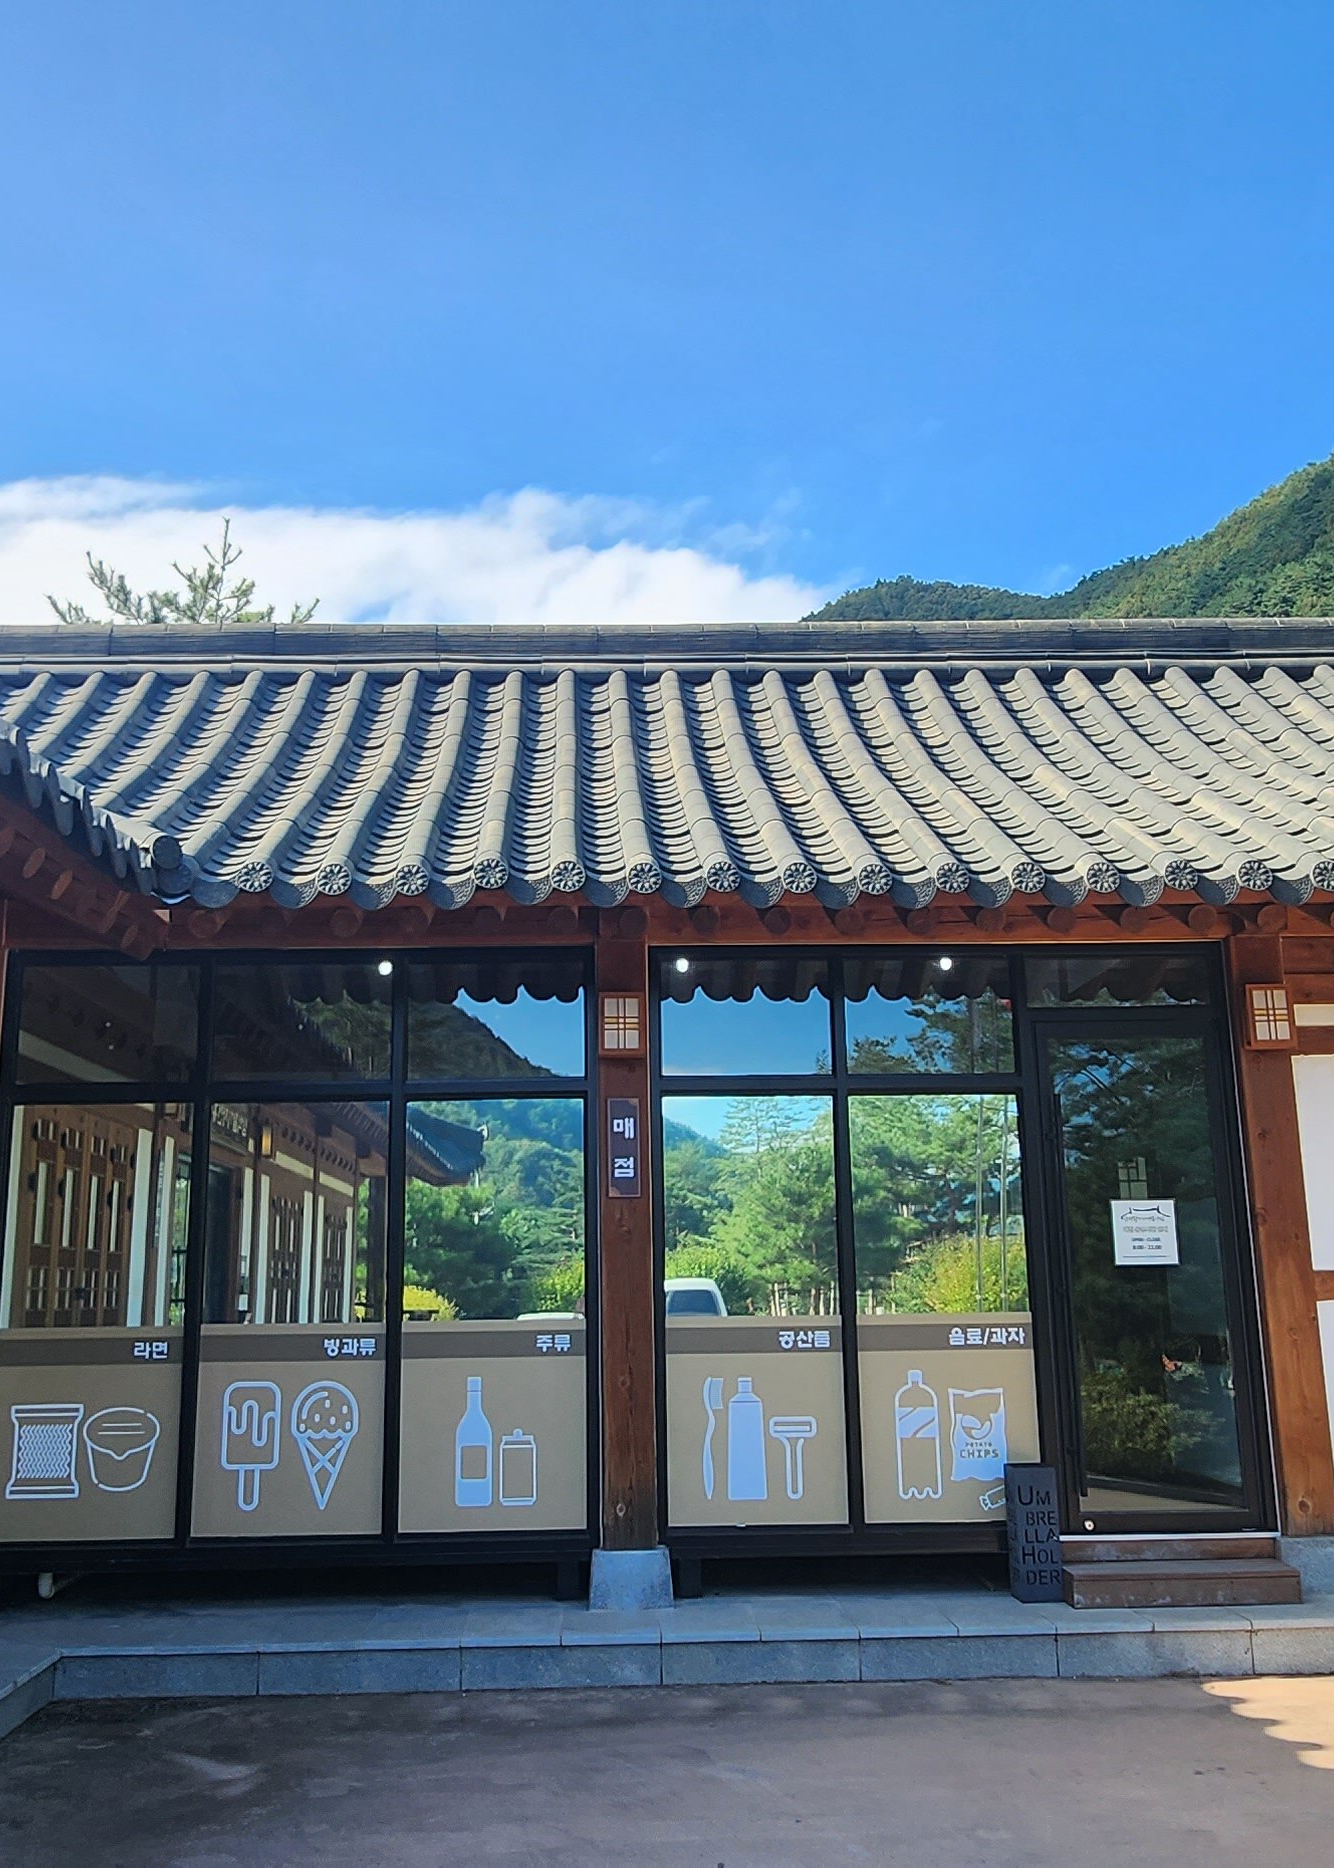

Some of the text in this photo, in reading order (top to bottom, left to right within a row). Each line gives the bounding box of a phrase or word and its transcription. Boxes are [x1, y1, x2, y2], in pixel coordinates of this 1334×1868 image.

[536, 1334, 571, 1353] 주류
[778, 1330, 831, 1350] 공산품
[948, 1326, 1026, 1346] 음료/과자
[133, 1341, 168, 1360] 라면
[323, 1338, 376, 1357] 빙과류
[959, 1448, 1000, 1459] CHIPS
[1026, 1510, 1057, 1526] BRE
[1024, 1527, 1060, 1544] LLA
[1026, 1569, 1061, 1585] DER
